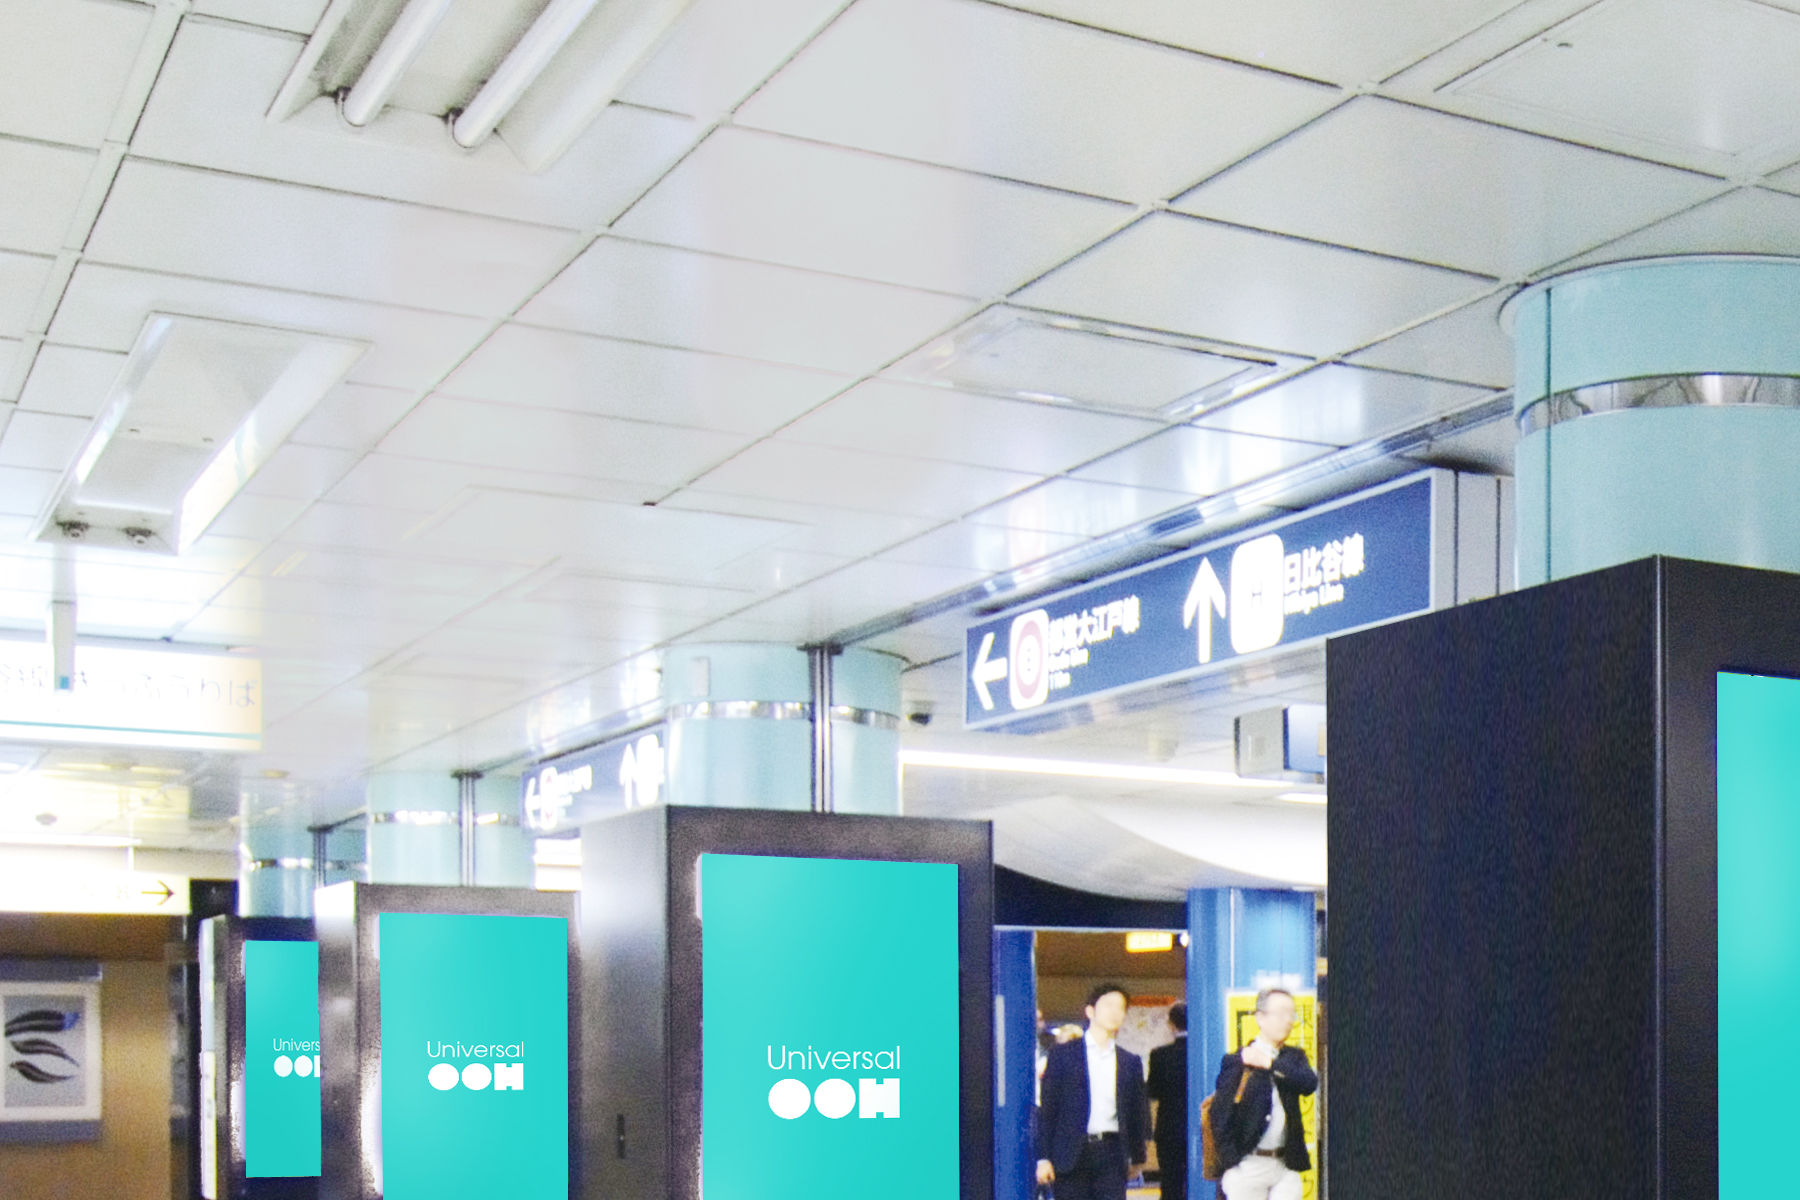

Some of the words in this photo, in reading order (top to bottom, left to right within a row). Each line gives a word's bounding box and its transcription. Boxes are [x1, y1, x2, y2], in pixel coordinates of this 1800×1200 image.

[273, 1038, 320, 1051] Univers
[427, 1041, 524, 1058] Universal
[768, 1046, 900, 1069] Universal
[427, 1063, 524, 1090] OOH
[768, 1078, 900, 1119] OOH
